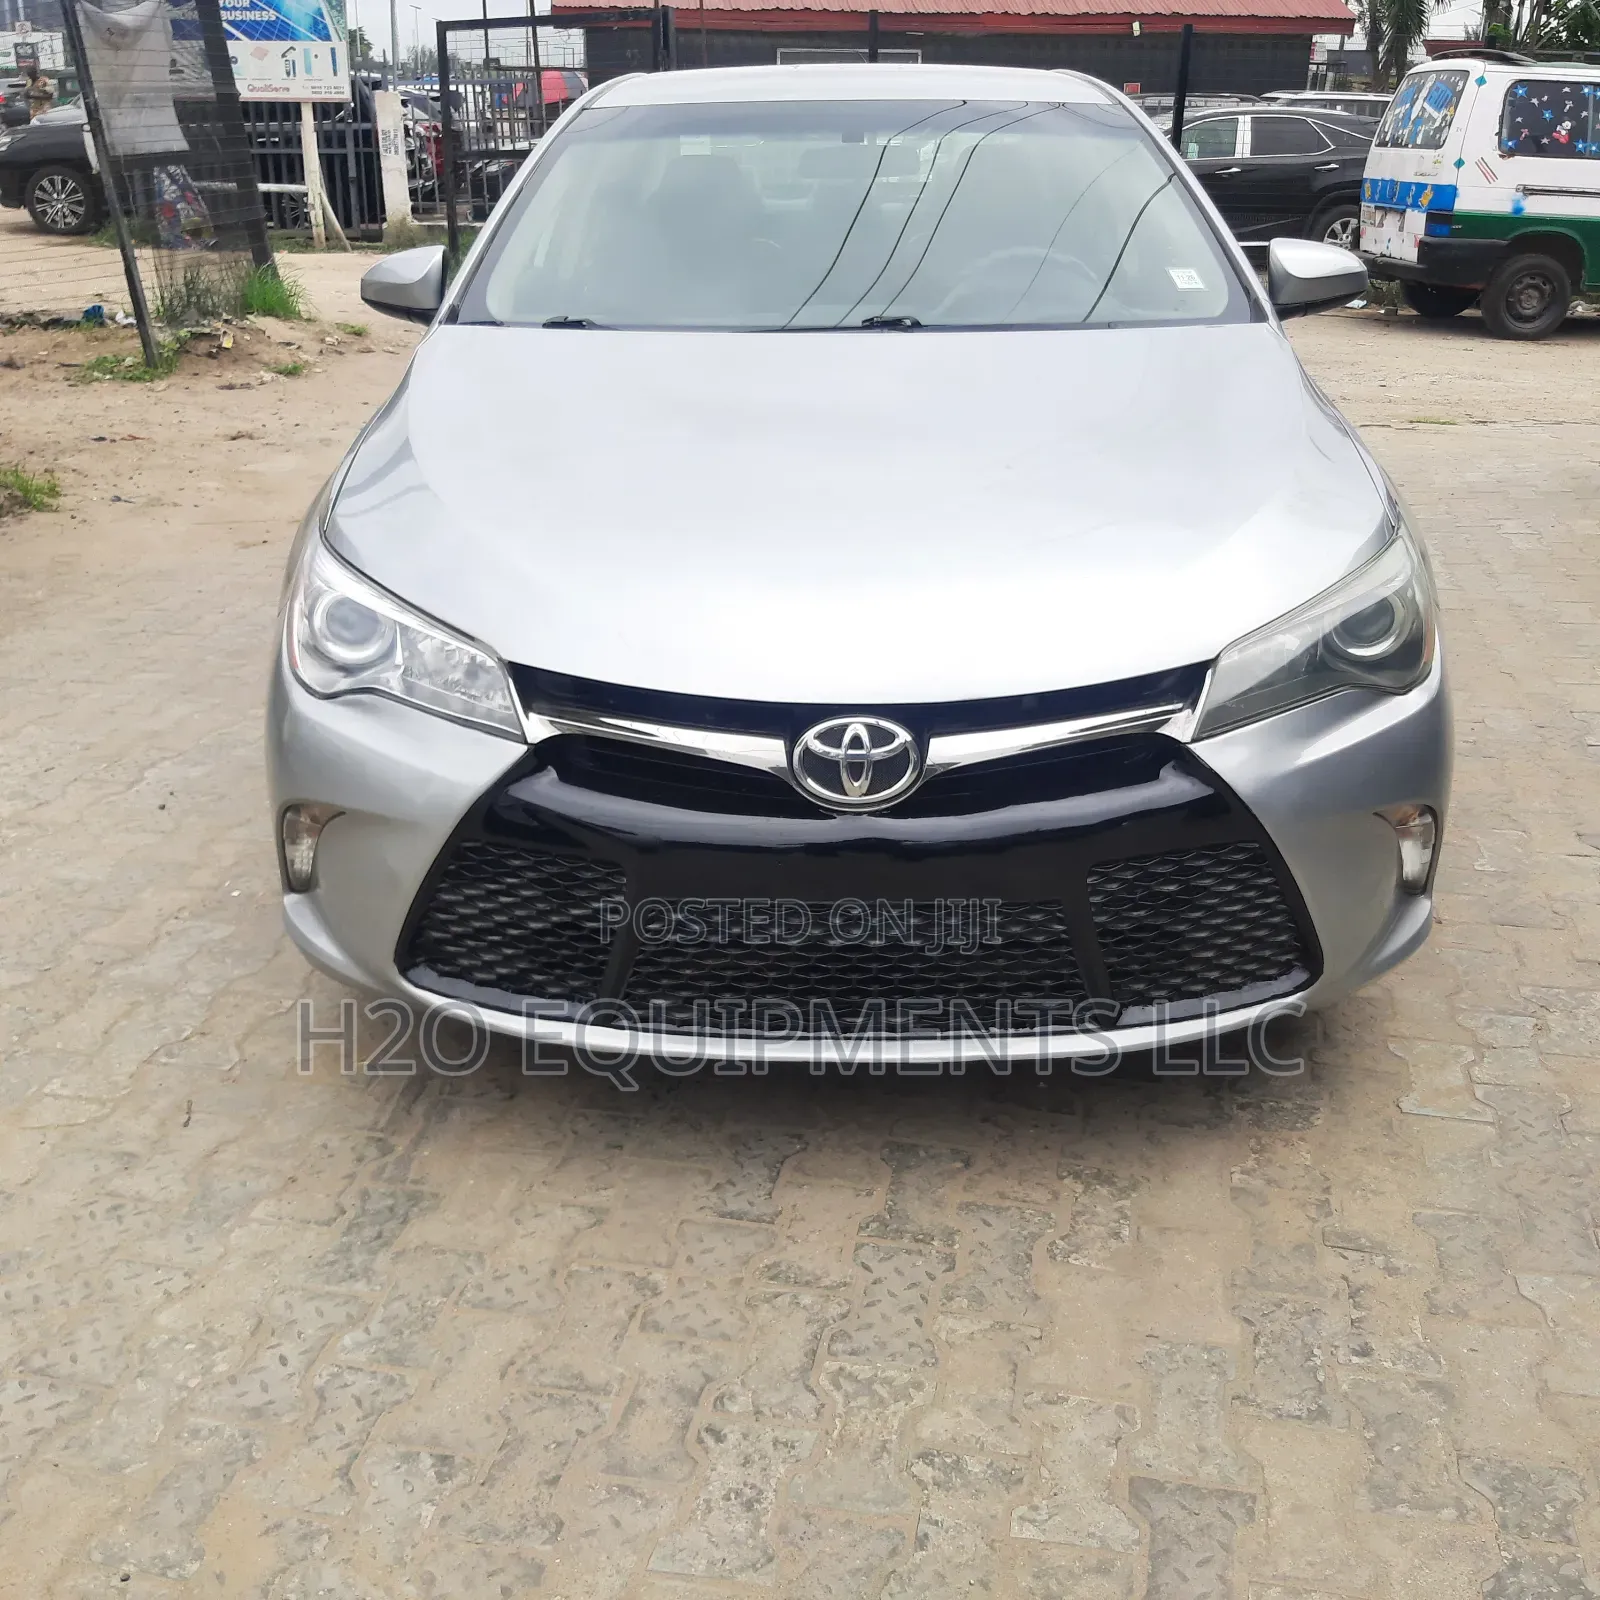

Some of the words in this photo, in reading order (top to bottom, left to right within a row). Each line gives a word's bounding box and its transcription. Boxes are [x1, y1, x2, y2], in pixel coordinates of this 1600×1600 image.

[218, 0, 250, 8] YOUR
[220, 10, 277, 21] BUSINESS
[247, 83, 290, 93] QualiServe
